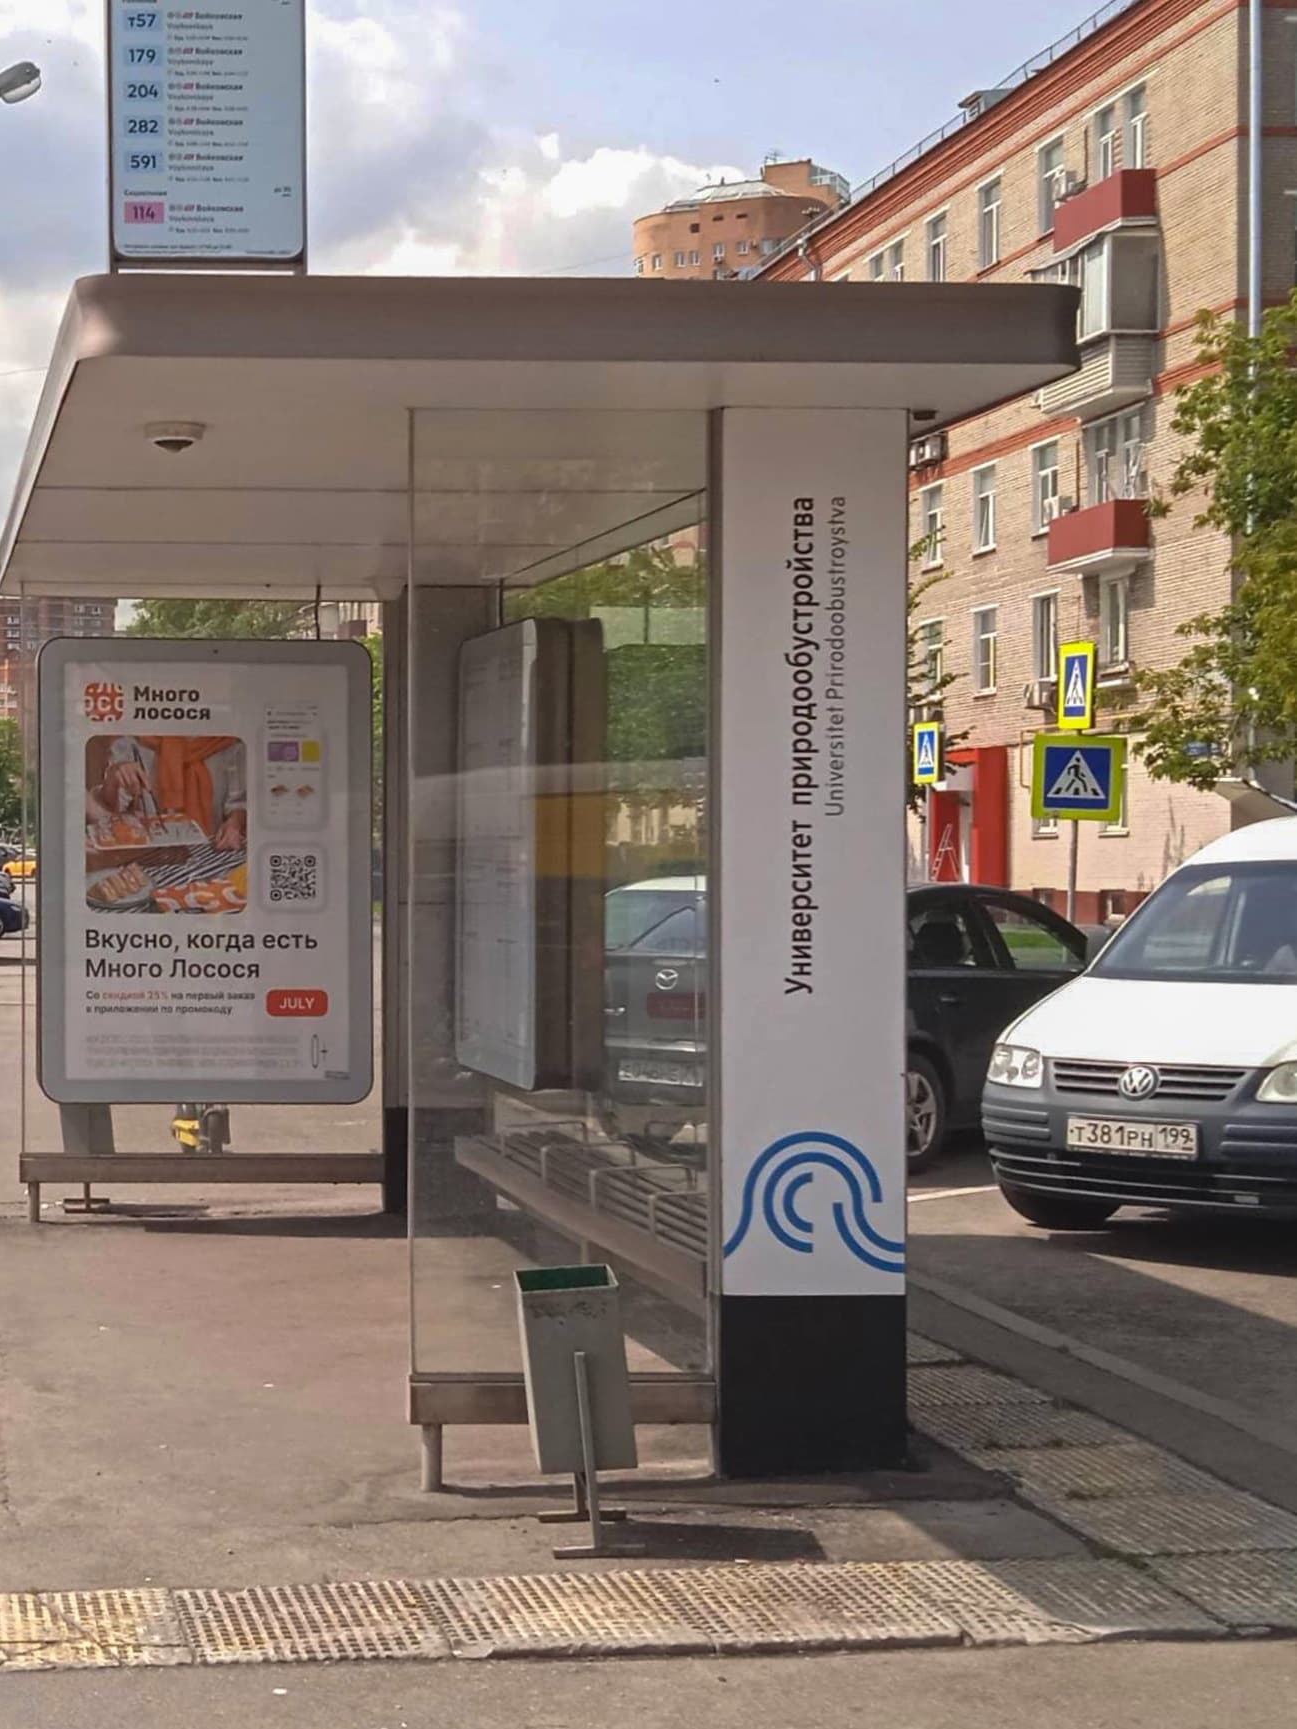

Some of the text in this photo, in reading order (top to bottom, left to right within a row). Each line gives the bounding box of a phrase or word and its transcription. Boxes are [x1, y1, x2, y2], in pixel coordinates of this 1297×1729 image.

[127, 14, 156, 28] т57
[129, 49, 156, 63] 179
[127, 84, 158, 98] 204
[128, 119, 159, 134] 282
[130, 155, 157, 169] 591
[132, 206, 156, 220] 114
[824, 496, 850, 817] Universitet Prirodoobustroystva
[133, 685, 200, 702] Много
[133, 707, 211, 720] лосося
[784, 496, 820, 994] Университет природообустройства
[85, 928, 319, 954] Вкусно, когда есть
[85, 957, 261, 979] Много Лосося
[86, 990, 101, 1000] Со
[279, 998, 315, 1010] JULY
